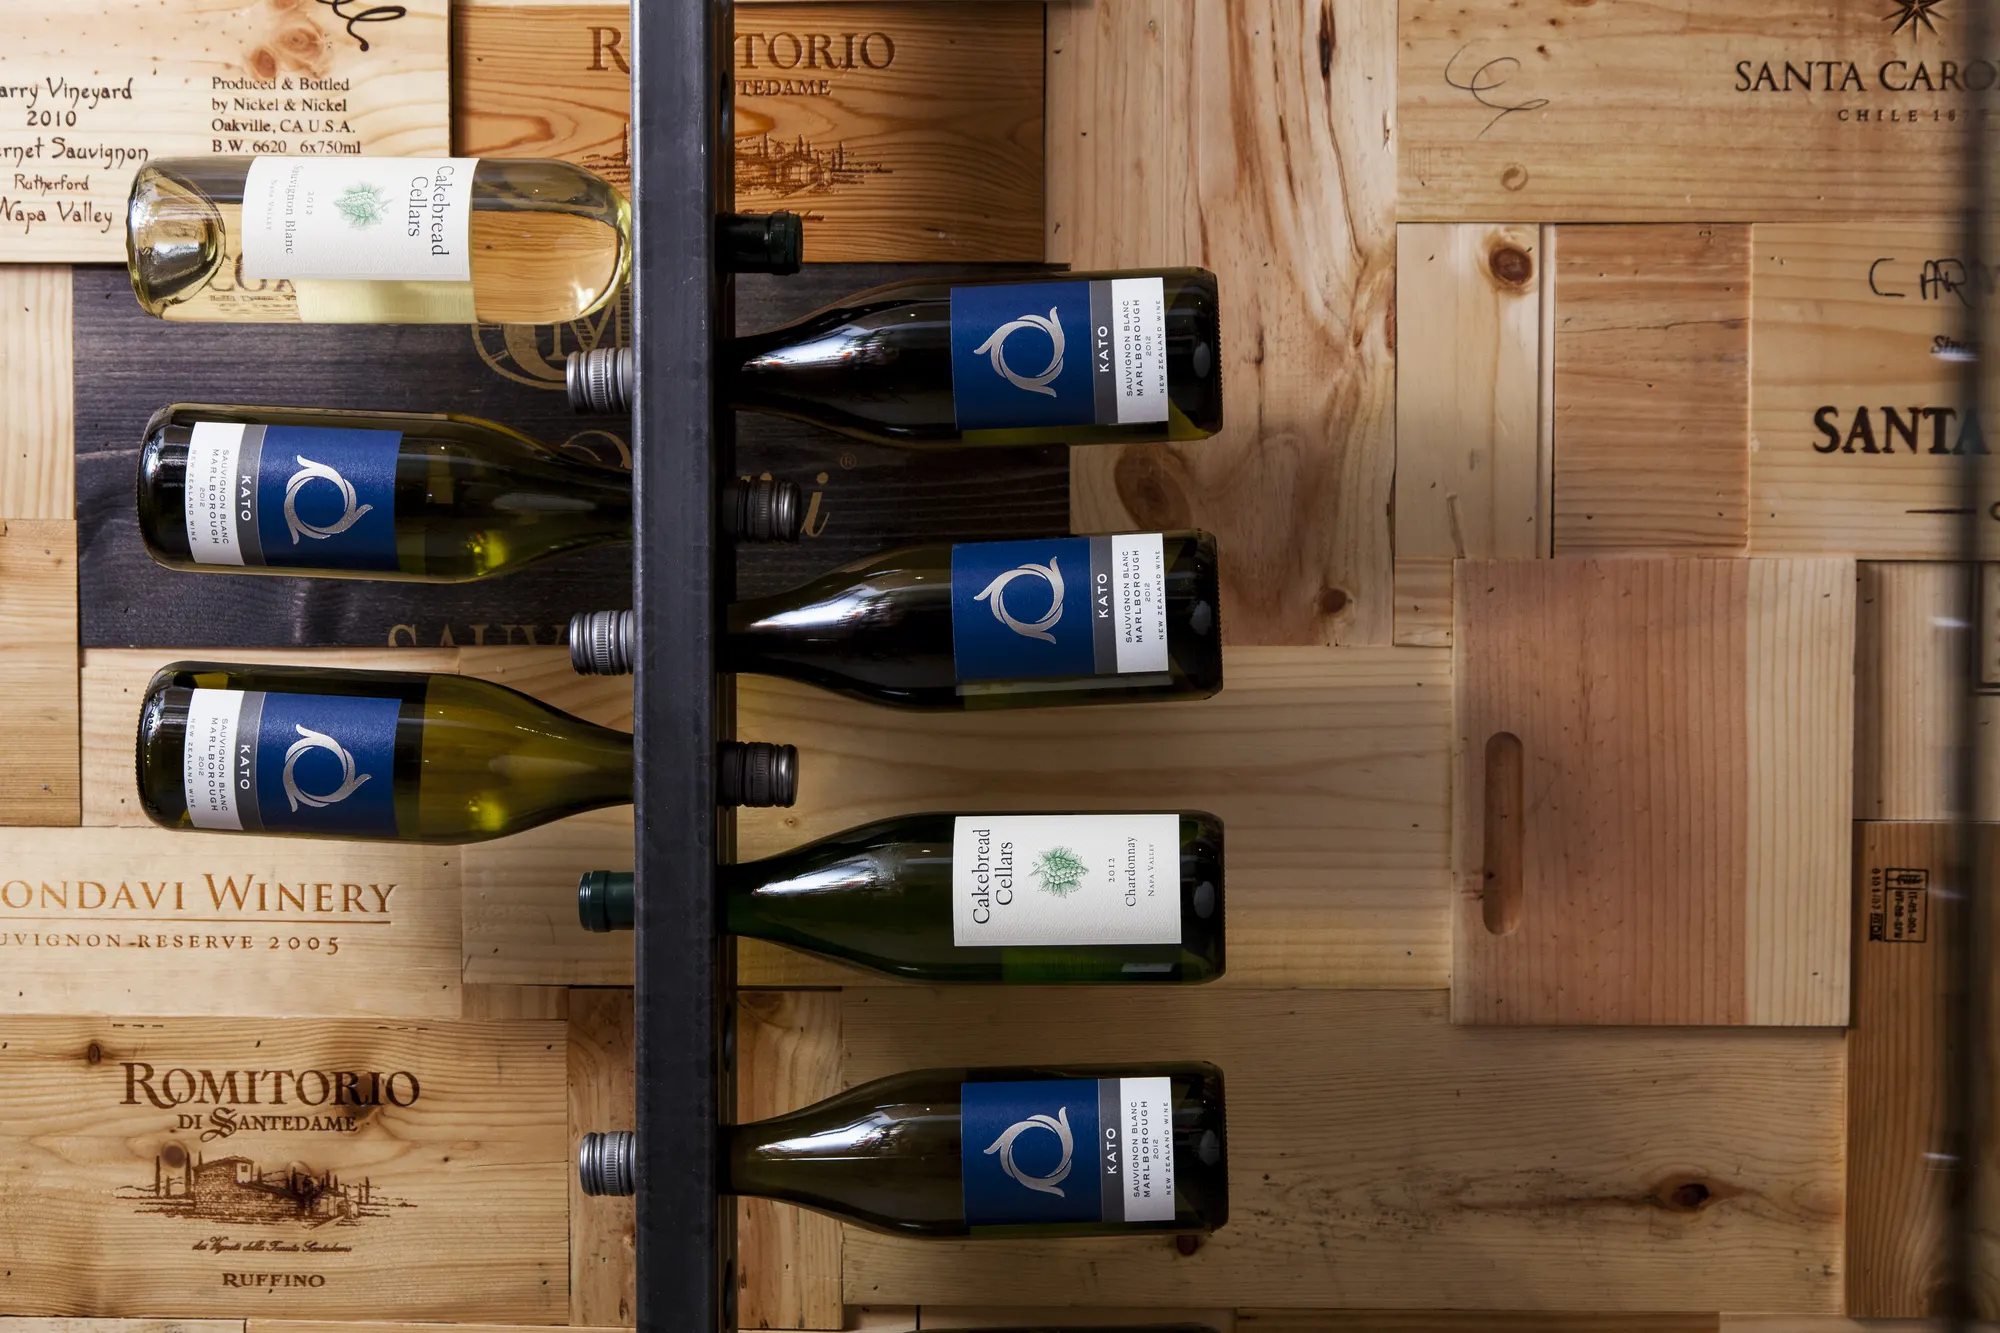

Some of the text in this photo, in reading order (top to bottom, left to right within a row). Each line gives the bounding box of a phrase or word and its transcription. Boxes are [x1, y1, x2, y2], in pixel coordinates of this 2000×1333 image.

[586, 26, 895, 74] RTORIO
[46, 77, 134, 109] Vineyard
[212, 76, 349, 91] Produced & Bottled
[1735, 60, 2000, 92] SANTA CARO
[27, 110, 77, 126] 2010
[212, 98, 347, 114] by Nickel & Nickel
[212, 118, 355, 134] Oakville, CA U.S.A.
[1838, 109, 1918, 122] CHILE
[0, 137, 149, 170] rnet Sauvignon
[212, 139, 361, 154] B.W. 6620 6x750ml
[14, 174, 90, 197] Rutherford
[305, 191, 315, 215] 2012
[408, 176, 429, 237] Cellars
[0, 196, 113, 235] Napa Valley
[284, 165, 304, 255] Sauvignon Blanc
[431, 165, 455, 256] Cakebread
[1097, 325, 1110, 372] KATO
[1122, 300, 1133, 397] SAUVIGNON BLANC
[1133, 299, 1144, 396] MARLBOROUGH
[1812, 405, 1991, 454] SANTA
[209, 448, 220, 545] MARLBOROUGH
[219, 449, 230, 545] SAUVIGNON BLANC
[241, 475, 251, 522] KATO
[189, 520, 197, 542] WINE
[1096, 573, 1109, 618] KATO
[1121, 550, 1133, 643] SAUVIGNON BLANC
[1132, 550, 1143, 643] MARLBOROUGH
[208, 717, 218, 811] MARLBOROUGH
[218, 718, 229, 812] SAUVIGNON BLANC
[240, 744, 251, 790] KATO
[188, 788, 196, 809] WINE
[971, 829, 991, 925] Cakebread
[994, 841, 1014, 906] Cellars
[1108, 857, 1116, 883] 2012
[1124, 836, 1137, 907] Chardonnay
[1147, 843, 1155, 871] VALLEY
[1, 873, 398, 913] ONDAVI WINERY
[137, 934, 253, 949] RESERVE
[269, 936, 339, 956] 2005
[119, 1062, 420, 1109] ROMITORIO
[176, 1106, 358, 1143] DI SANTEDAME
[1105, 1127, 1117, 1174] KATO
[1130, 1101, 1141, 1198] SAUVIGNON BLANC
[1140, 1101, 1151, 1198] MARLBOROUGH
[222, 1272, 326, 1288] RUFFINO
